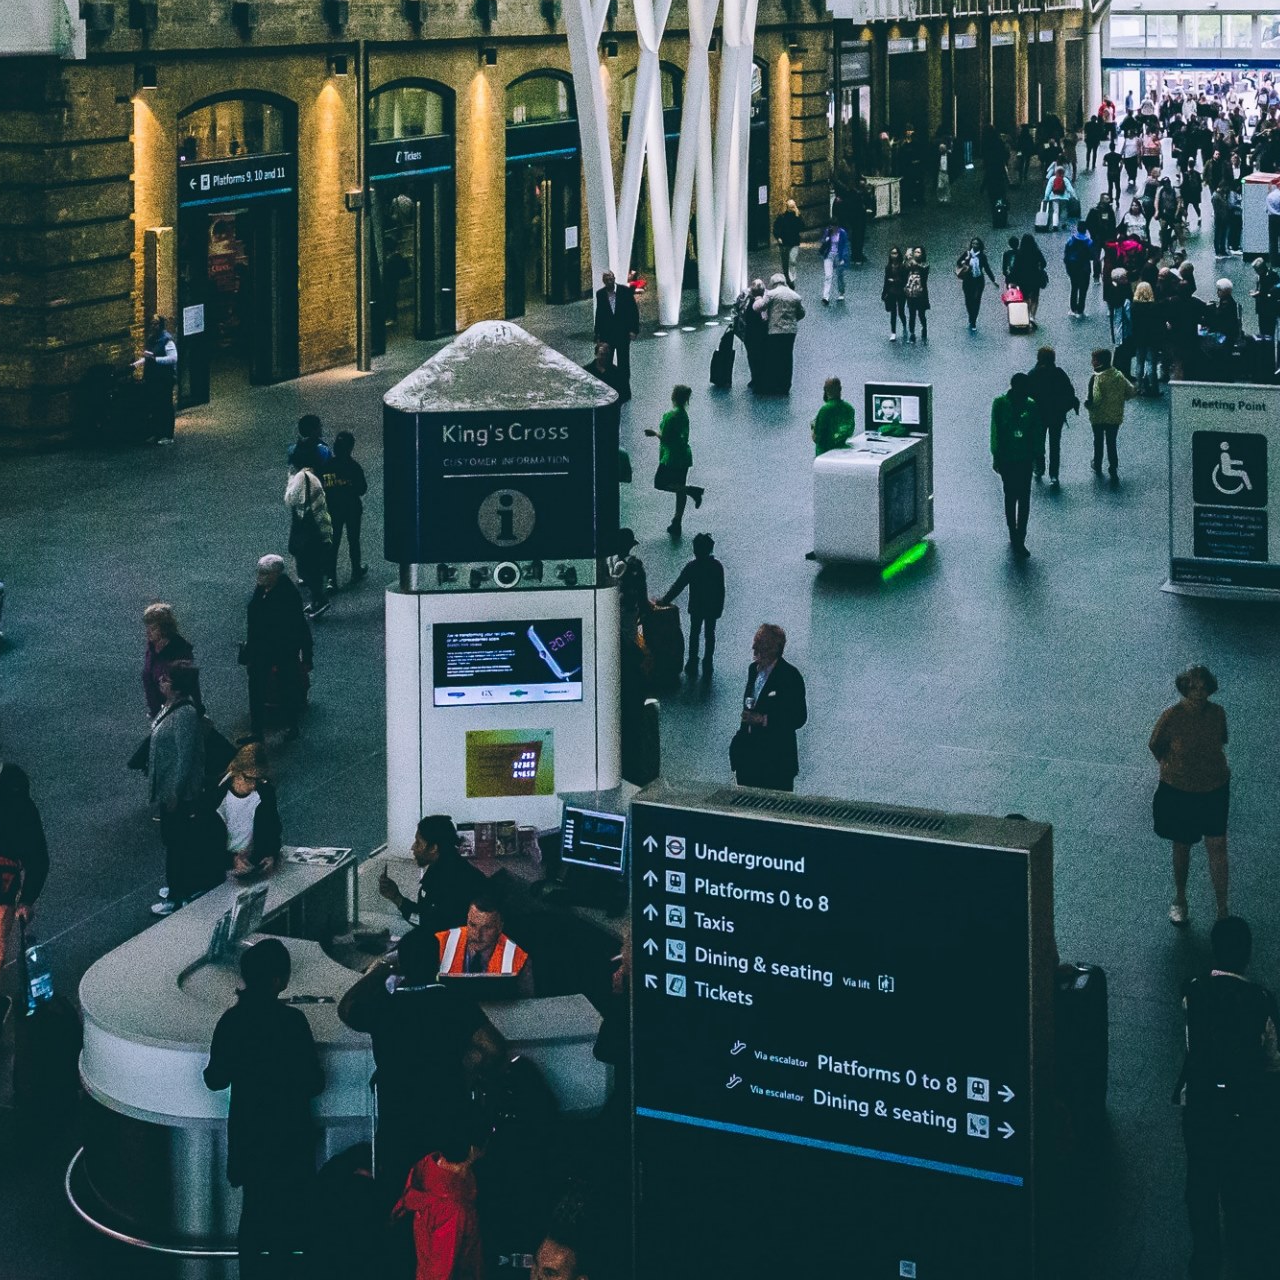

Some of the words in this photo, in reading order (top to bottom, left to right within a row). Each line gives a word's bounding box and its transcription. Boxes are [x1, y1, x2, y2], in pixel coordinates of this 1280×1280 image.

[403, 150, 422, 161] Tickets
[213, 174, 246, 188] Platforms
[254, 170, 264, 181] 10
[264, 169, 276, 180] and
[277, 167, 286, 179] 11
[1192, 398, 1236, 413] Meeting
[1238, 400, 1267, 412] Point
[442, 424, 504, 447] King's
[508, 422, 569, 440] Cross
[694, 842, 805, 873] Underground
[694, 878, 774, 904] Platforms
[779, 890, 790, 906] 0
[795, 893, 813, 910] to
[818, 896, 829, 912] 8
[694, 911, 735, 933] Taxis
[694, 946, 749, 974] Dining
[753, 956, 767, 973] &
[771, 961, 833, 987] seating
[842, 976, 857, 987] Via
[858, 978, 871, 990] lift
[694, 980, 753, 1006] Tickets
[754, 1050, 768, 1061] Via
[769, 1052, 809, 1068] escalator
[817, 1054, 901, 1084] Platforms
[905, 1070, 917, 1086] 0
[922, 1073, 941, 1091] to
[946, 1077, 958, 1094] 8
[750, 1084, 764, 1095] Via
[765, 1087, 804, 1102] escalator
[813, 1089, 869, 1117] Dining
[874, 1100, 888, 1118] &
[893, 1105, 957, 1133] seating
